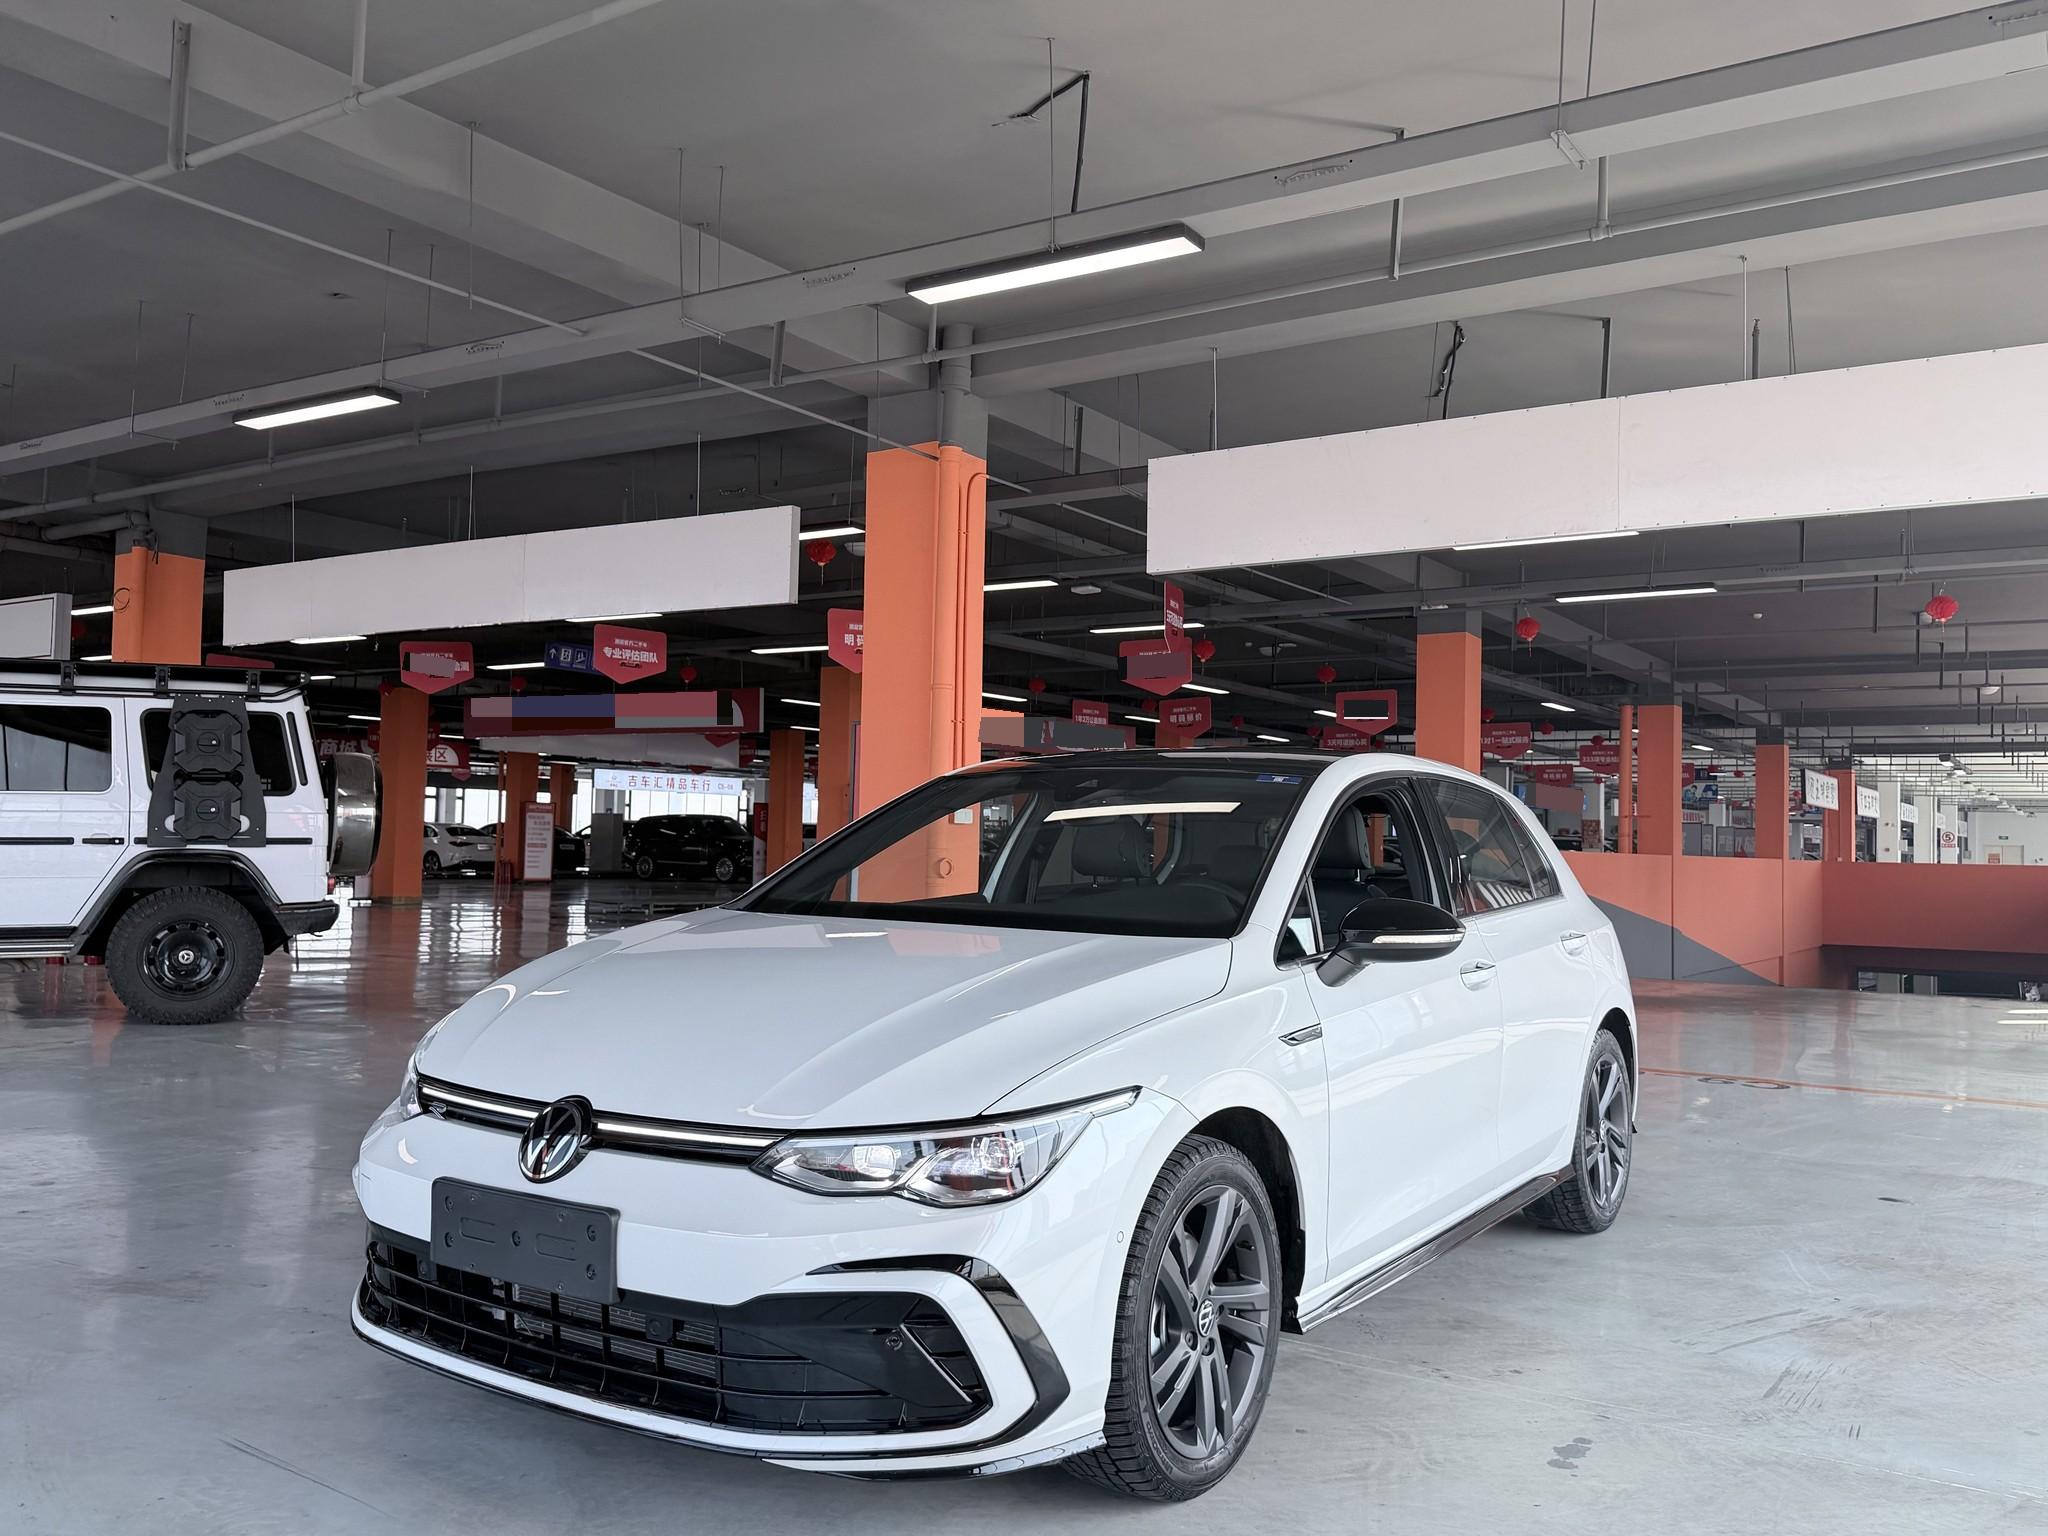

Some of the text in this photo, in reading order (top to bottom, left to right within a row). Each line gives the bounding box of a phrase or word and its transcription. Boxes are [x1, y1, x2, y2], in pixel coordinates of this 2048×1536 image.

[603, 647, 658, 663] 专业评估团队
[628, 775, 711, 791] 吉车汇精品车行
